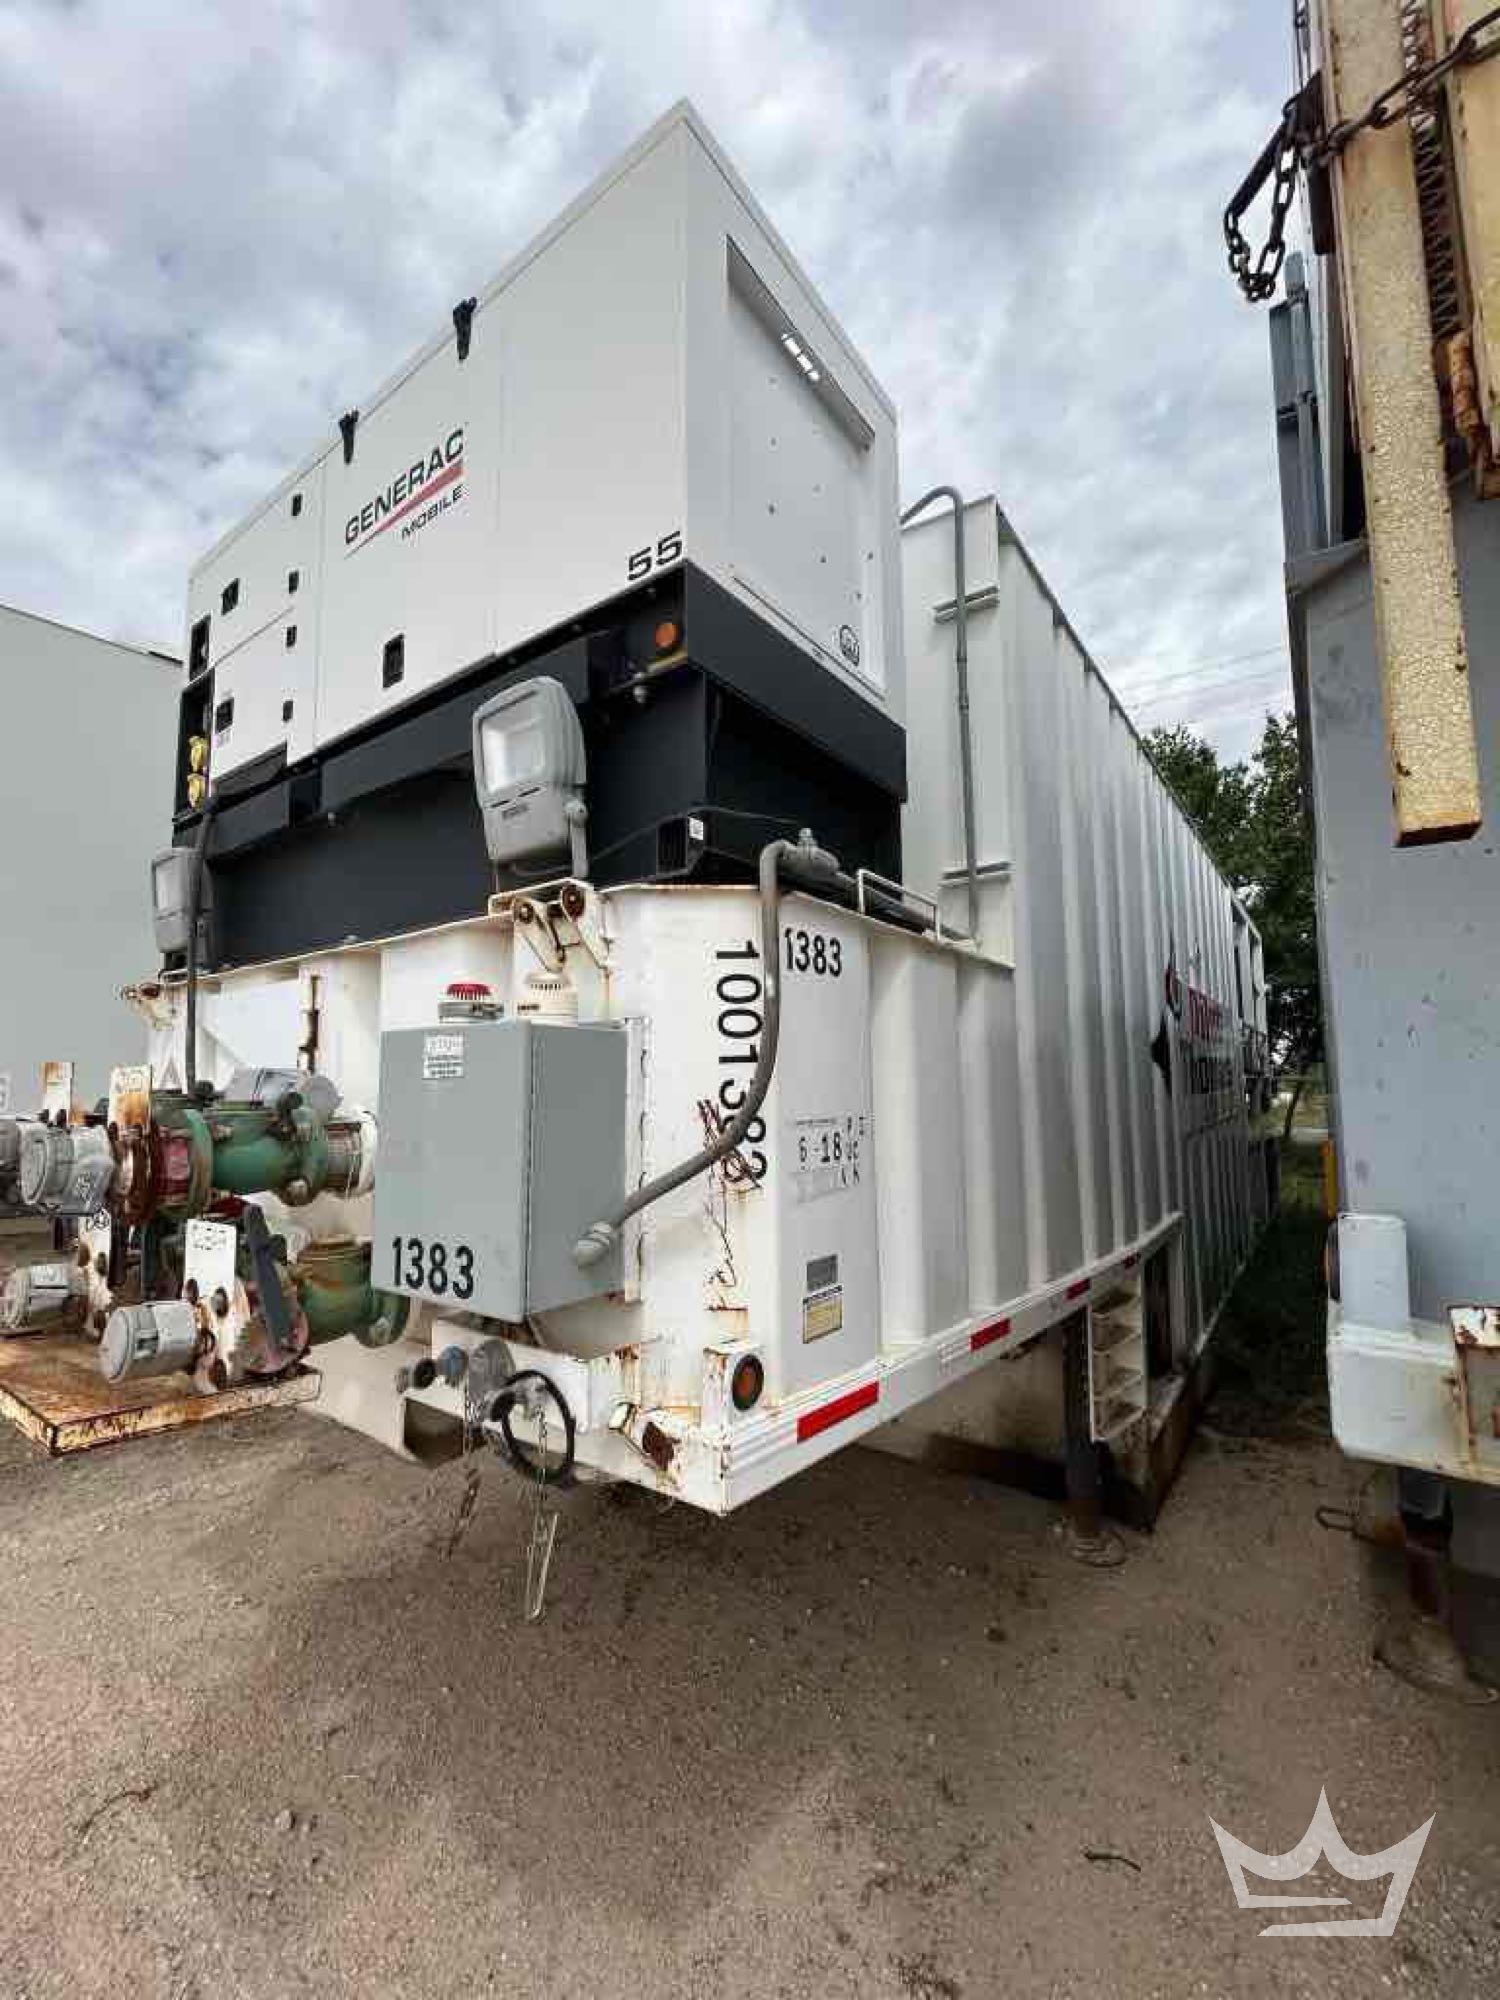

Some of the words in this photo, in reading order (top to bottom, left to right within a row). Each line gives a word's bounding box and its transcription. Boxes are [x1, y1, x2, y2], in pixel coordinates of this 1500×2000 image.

[345, 428, 464, 544] GENERAC
[401, 484, 464, 541] MOBILE
[627, 530, 682, 581] 55
[784, 927, 842, 977] 1383
[392, 1235, 474, 1300] 1383
